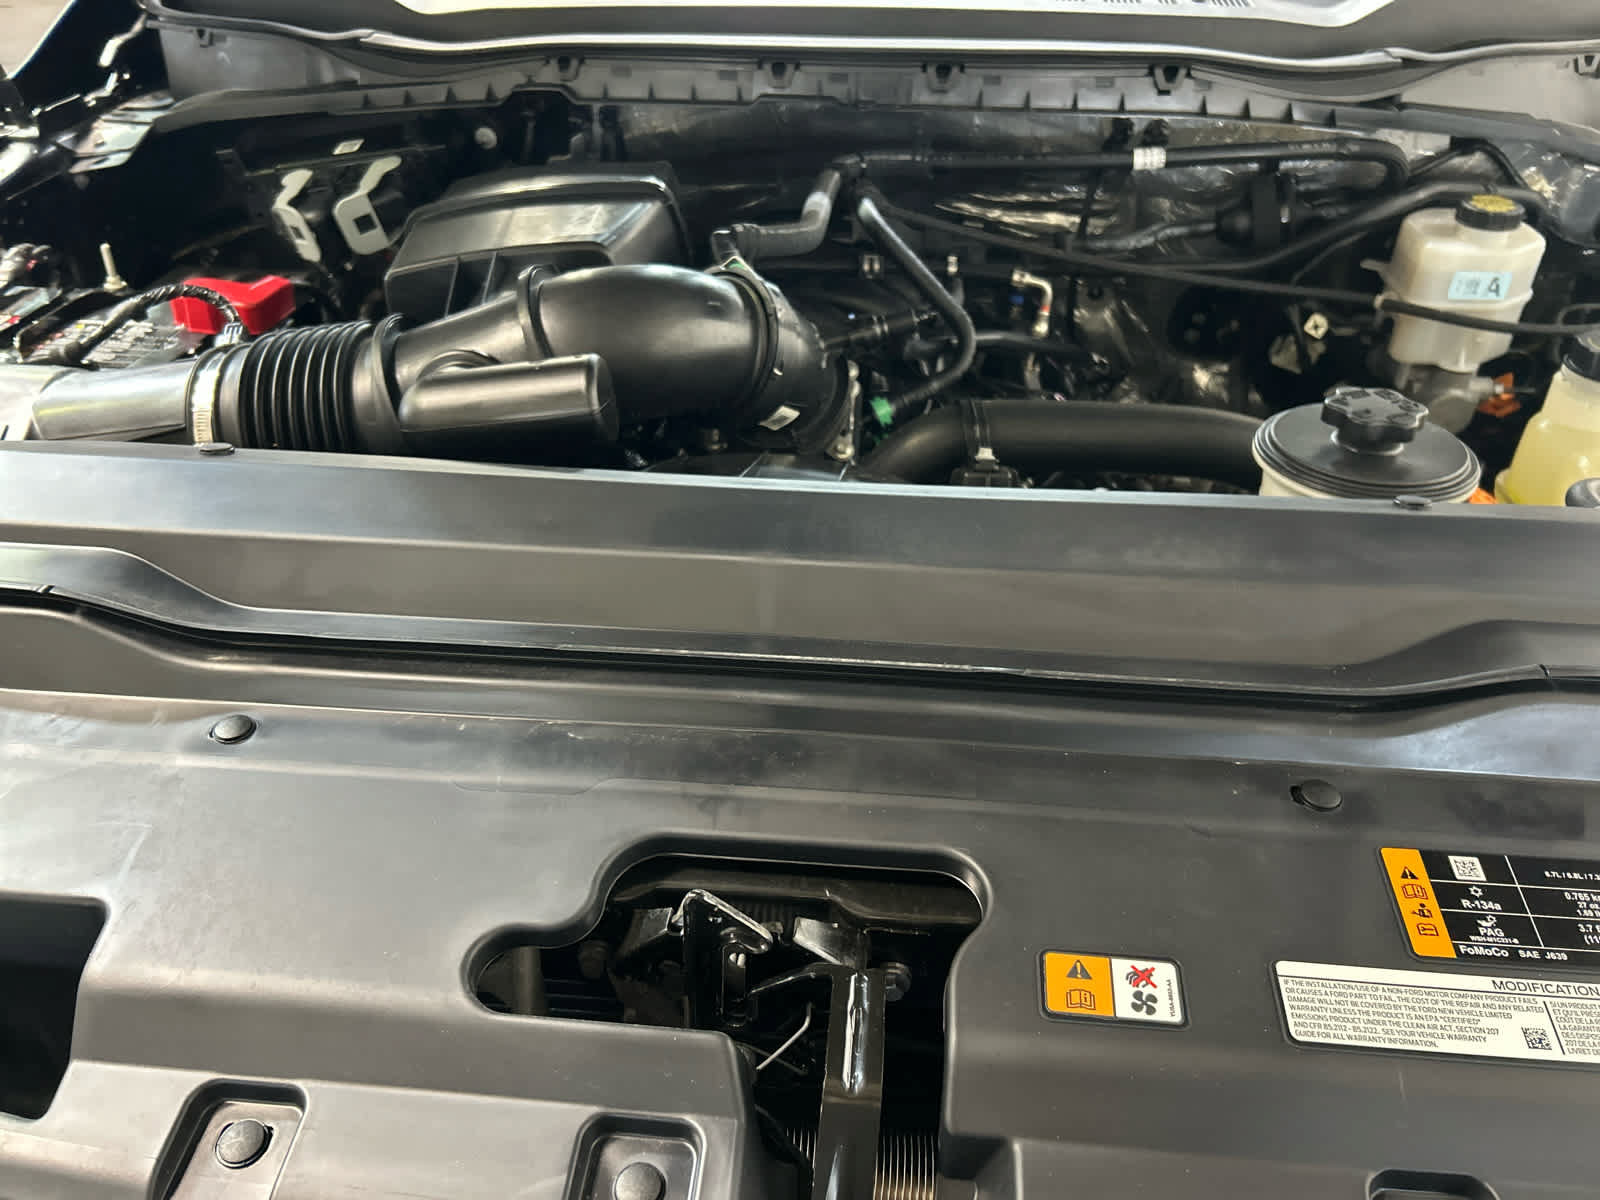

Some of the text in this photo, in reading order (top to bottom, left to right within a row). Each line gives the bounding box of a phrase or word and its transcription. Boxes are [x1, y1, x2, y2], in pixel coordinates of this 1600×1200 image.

[1564, 891, 1590, 901] 0.765
[1460, 899, 1502, 911] R-134a
[1576, 901, 1587, 909] 27
[1478, 926, 1505, 937] PAG
[1577, 923, 1593, 933] 3.7
[1458, 945, 1568, 961] FoMoCo SAE J639
[1306, 981, 1370, 992] INSTALLATION/USE
[1424, 990, 1449, 998] MOTOR
[1450, 992, 1483, 1000] COMPANY
[1485, 994, 1517, 1003] PRODUCT
[1287, 996, 1316, 1004] DAMAGE
[1360, 1001, 1393, 1010] COVERED
[1455, 1008, 1484, 1017] VEHICLE
[1485, 1011, 1513, 1019] LIMITED
[1296, 988, 1323, 996] CAUSES
[1350, 992, 1368, 1000] PART
[1456, 1000, 1481, 1008] REPAIR
[1513, 1004, 1545, 1013] RELATED
[1289, 1004, 1328, 1013] WARRANTY
[1330, 1007, 1357, 1015] UNLESS
[1372, 1011, 1405, 1019] PRODUCT
[1291, 1013, 1328, 1022] EMISSIONS
[1329, 1016, 1361, 1024] PRODUCT
[1363, 1018, 1387, 1026] UNDER
[1402, 1021, 1425, 1029] CLEAN
[1456, 1025, 1486, 1034] SECTION
[1295, 1030, 1317, 1038] GUIDE
[1346, 1033, 1386, 1044] WARRANTY
[1396, 1029, 1416, 1037] YOUR
[1417, 1031, 1446, 1039] VEHICLE
[1446, 1033, 1487, 1042] WARRANTY
